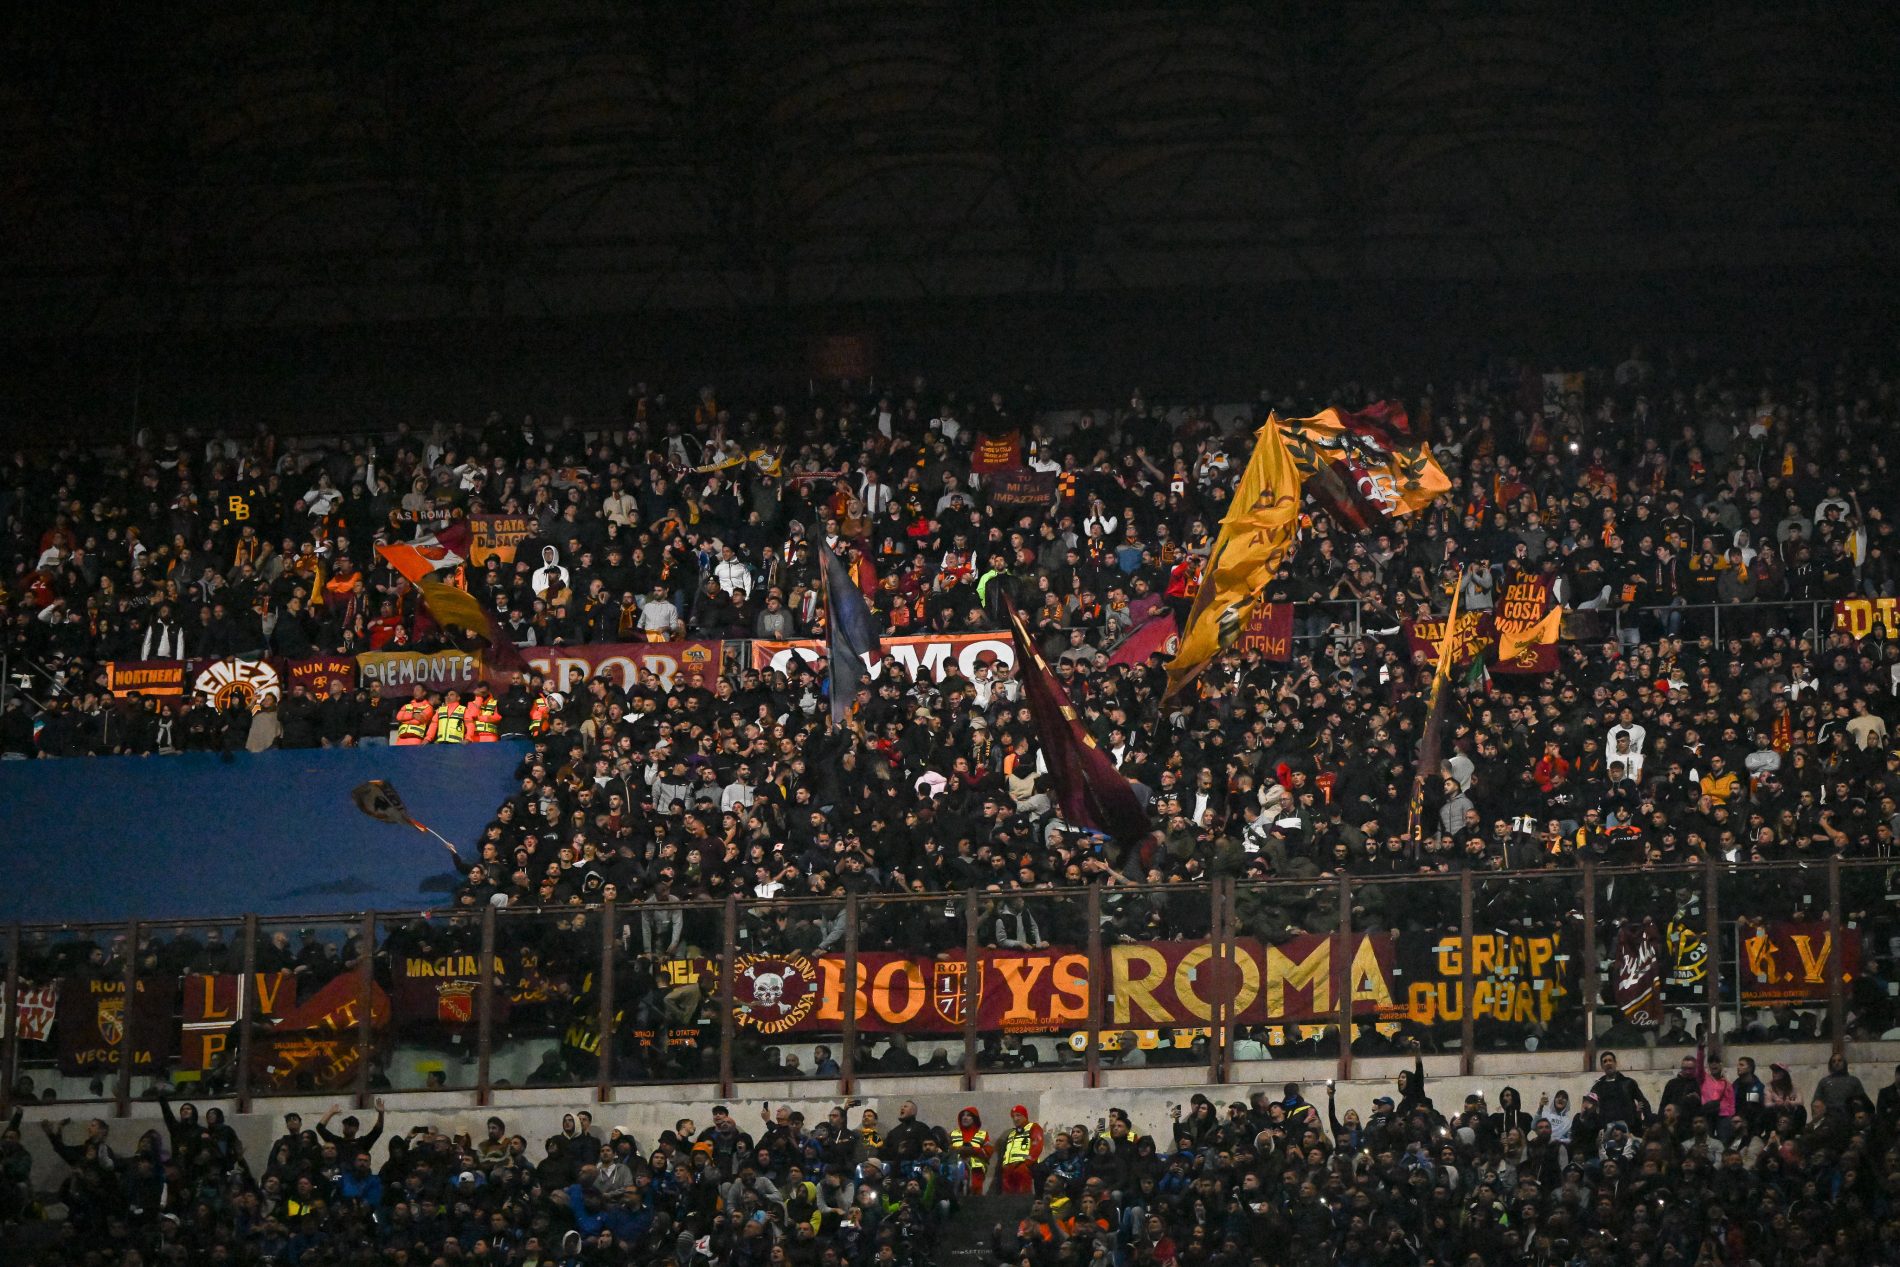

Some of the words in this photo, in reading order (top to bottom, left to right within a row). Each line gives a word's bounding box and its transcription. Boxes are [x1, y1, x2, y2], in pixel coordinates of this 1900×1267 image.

[1506, 584, 1546, 603] BELLA
[1504, 601, 1541, 620] COSA
[114, 668, 184, 686] NORTHERN
[328, 663, 351, 676] ME
[360, 656, 474, 689] PIEMONTE
[406, 955, 506, 978] MAGLIAA
[1111, 934, 1393, 1024] ROMA
[203, 974, 229, 1019] L
[255, 972, 285, 1015] V
[75, 1050, 152, 1065] VECCIA
[202, 1033, 227, 1071] P
